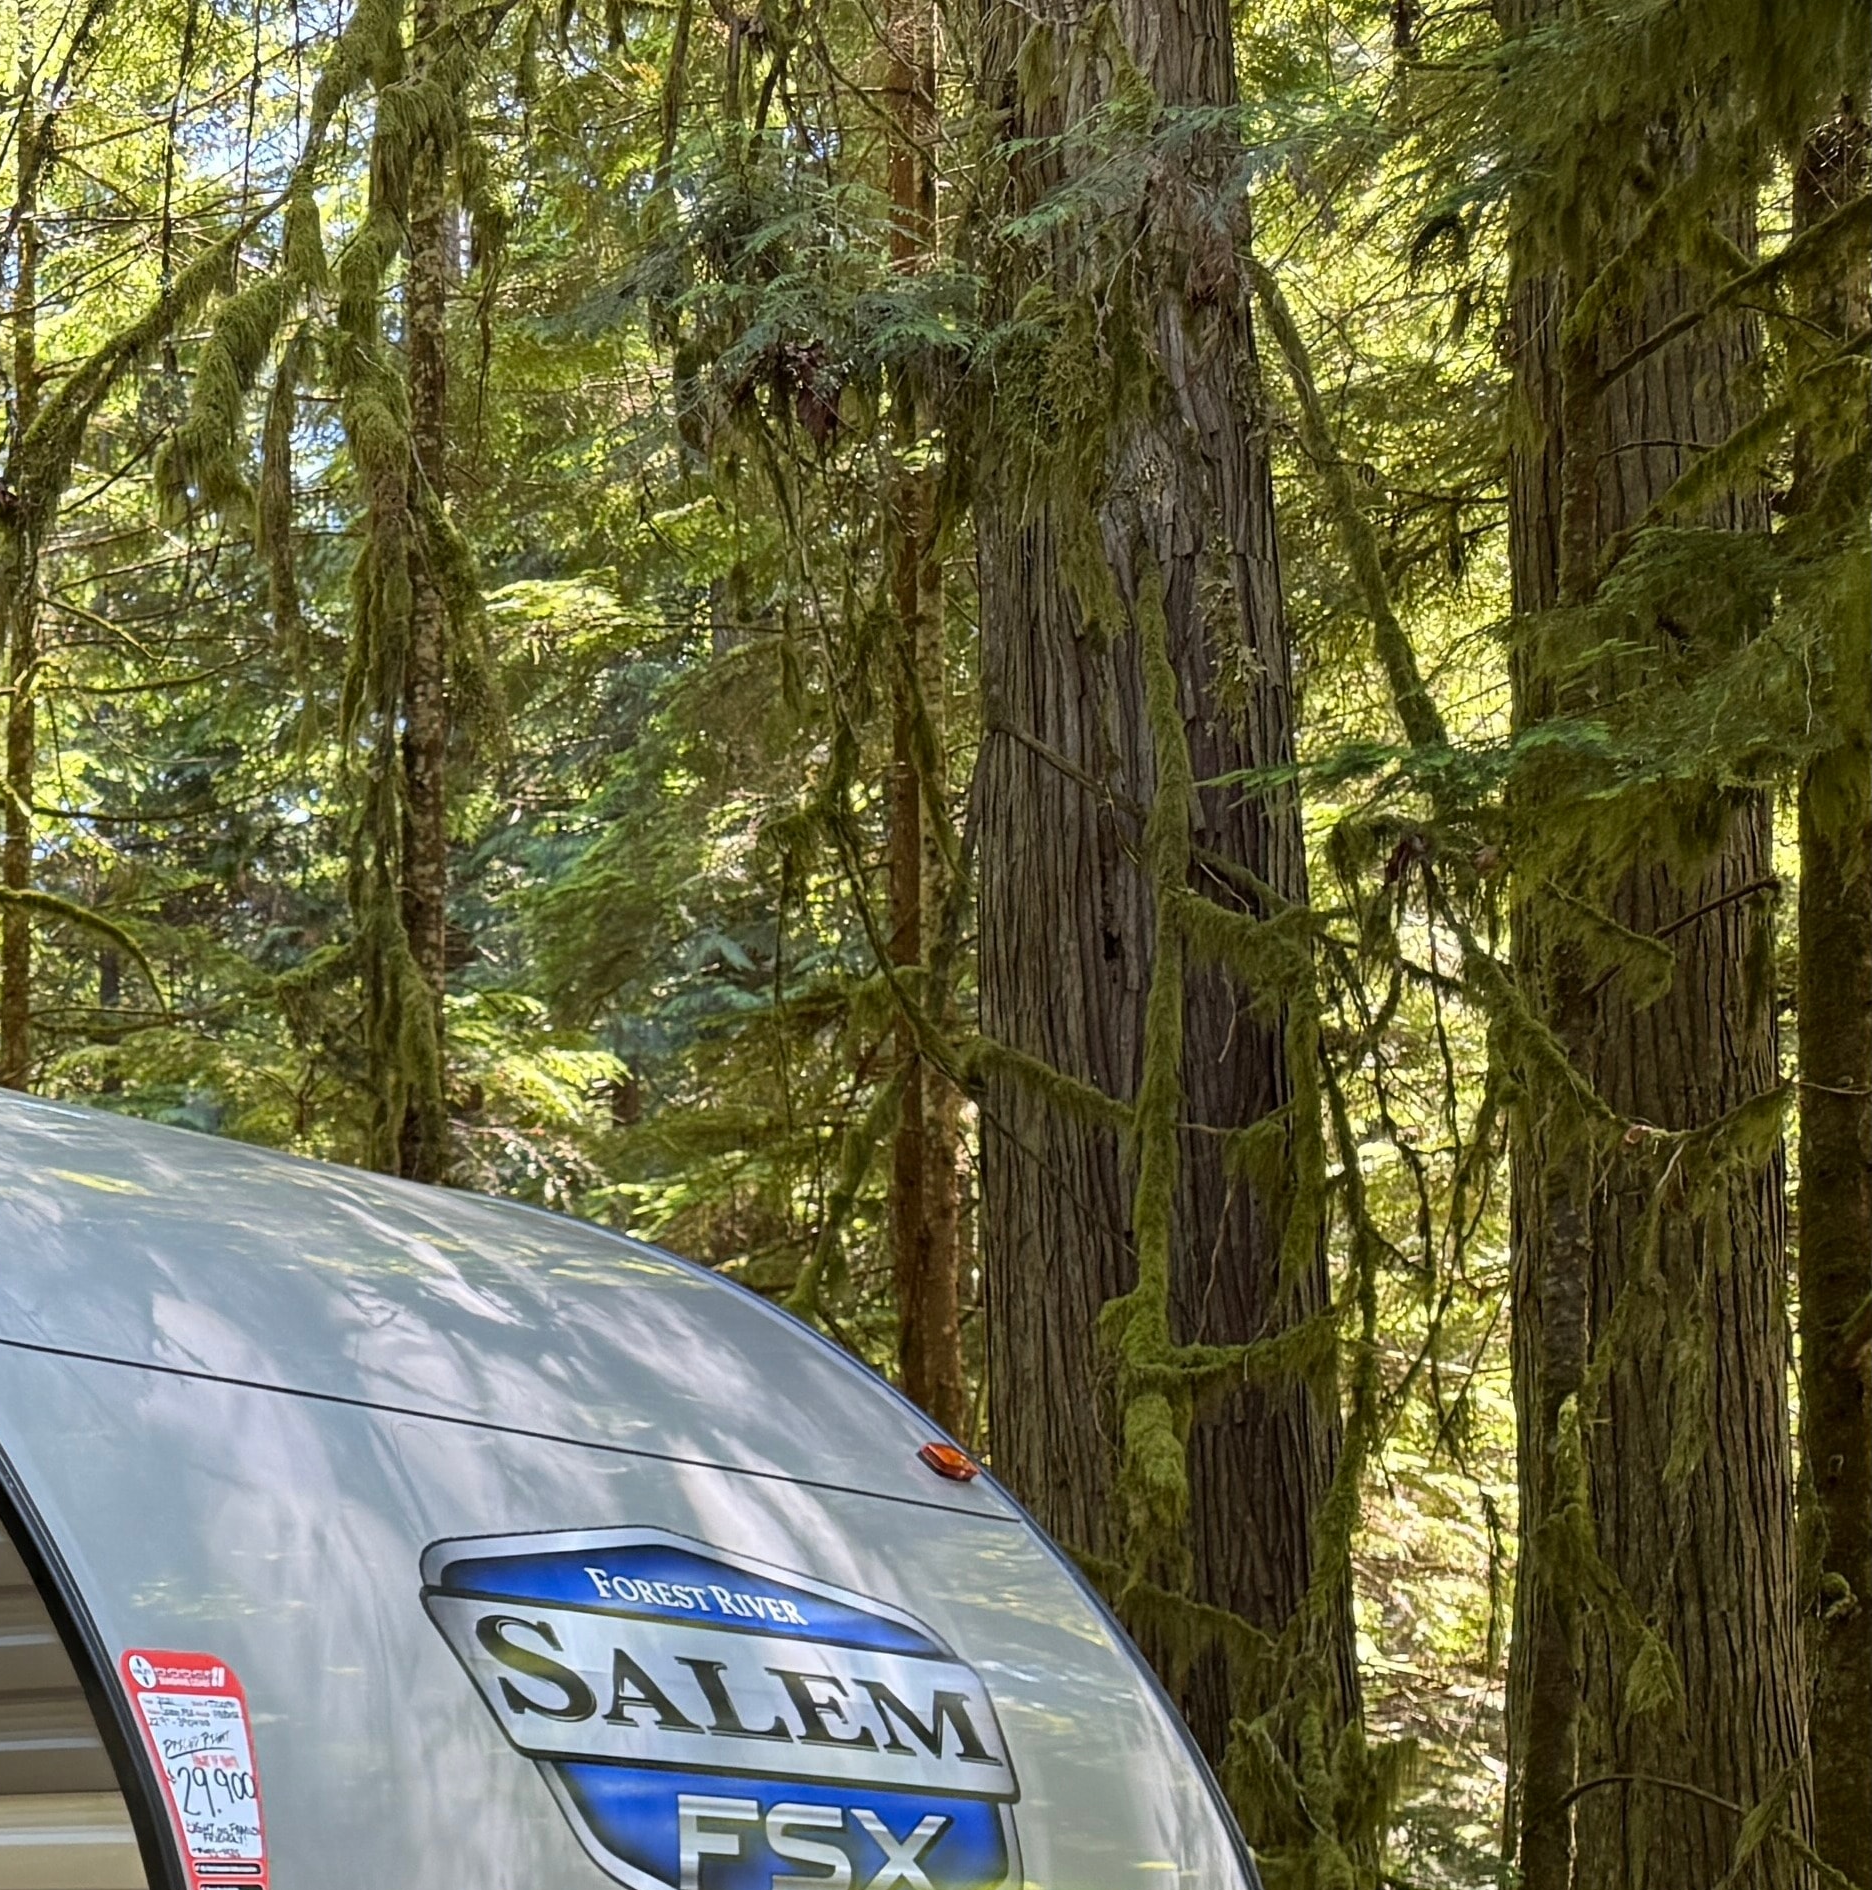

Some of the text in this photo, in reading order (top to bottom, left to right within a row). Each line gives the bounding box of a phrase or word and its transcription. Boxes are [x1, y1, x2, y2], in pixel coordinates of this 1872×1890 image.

[583, 1566, 809, 1627] FOREST RIVER
[474, 1614, 1004, 1768] SALEM
